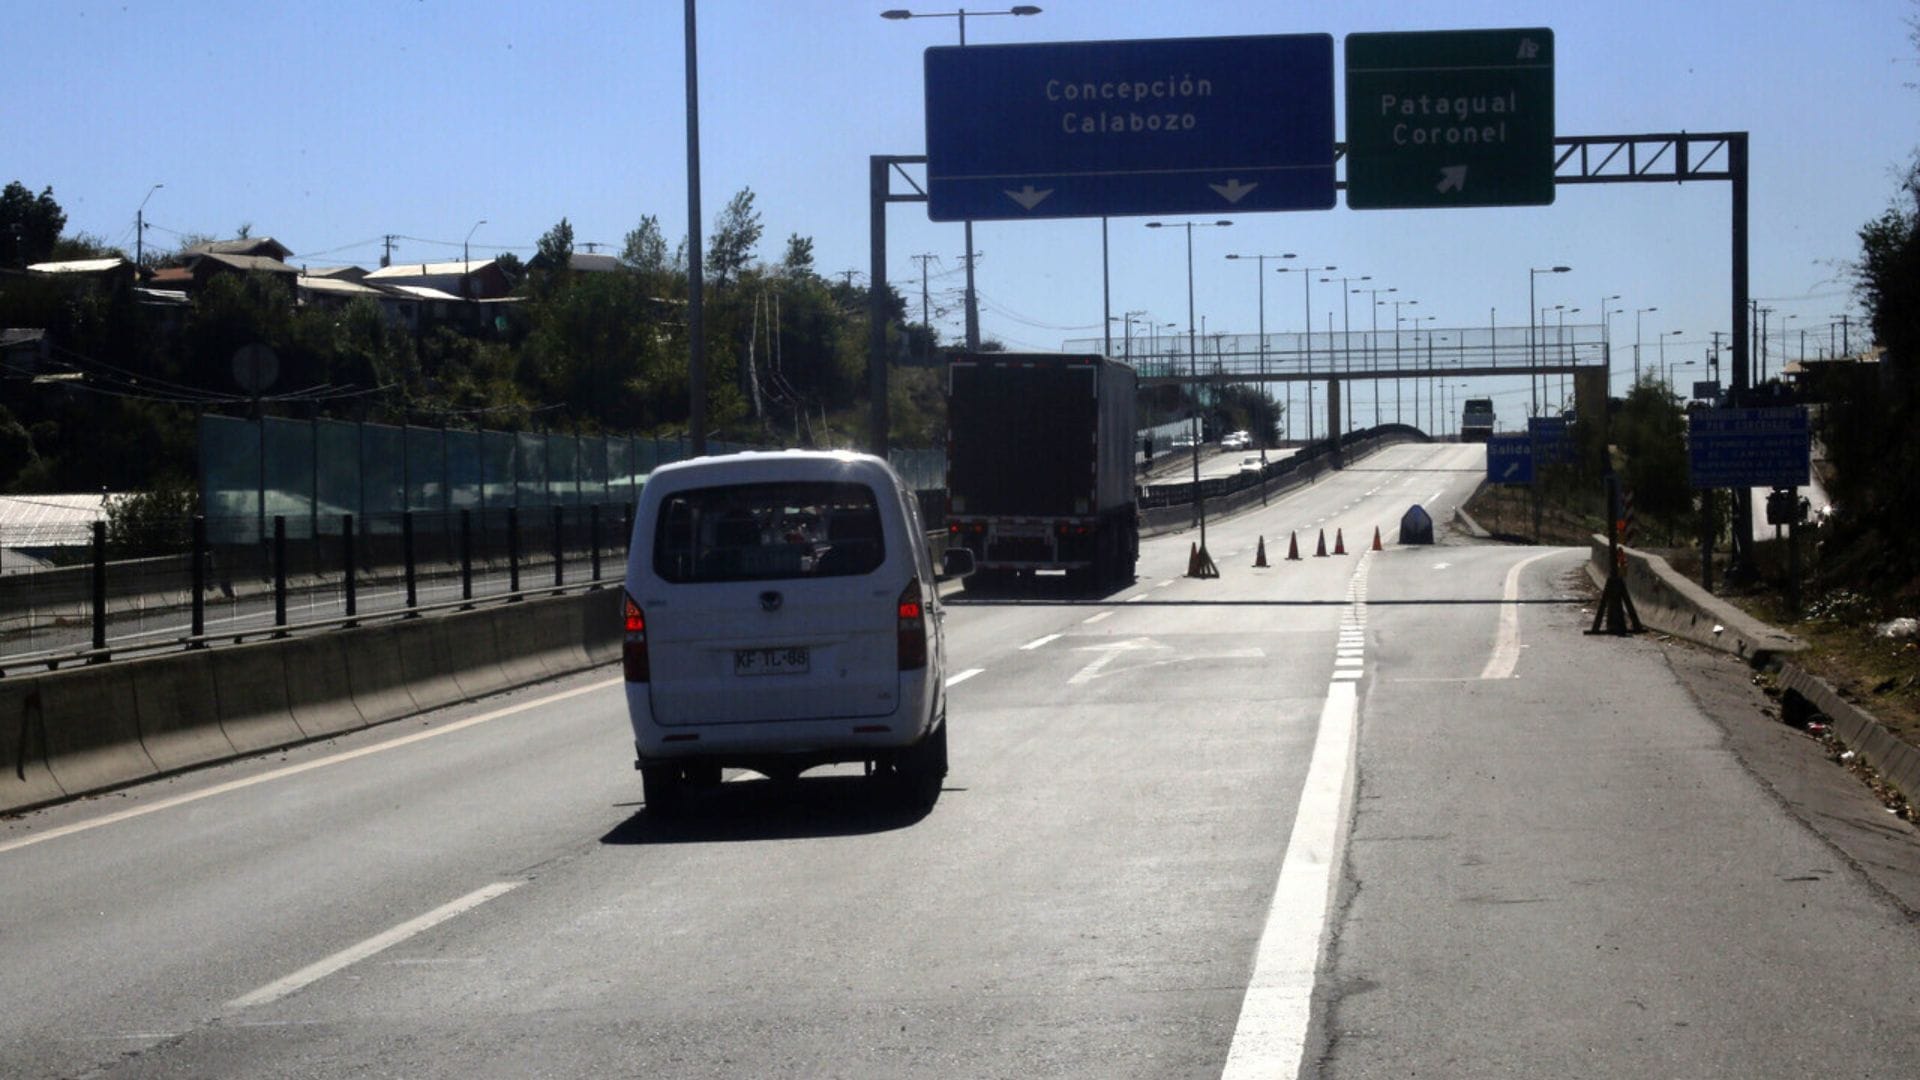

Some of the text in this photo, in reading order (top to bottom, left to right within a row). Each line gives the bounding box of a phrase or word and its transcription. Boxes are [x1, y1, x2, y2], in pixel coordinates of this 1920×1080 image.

[1045, 73, 1213, 102] Concepción
[1380, 89, 1517, 122] Patagual
[1062, 111, 1197, 134] Calabozo
[1392, 121, 1506, 146] Coronel
[1488, 442, 1531, 455] Salida
